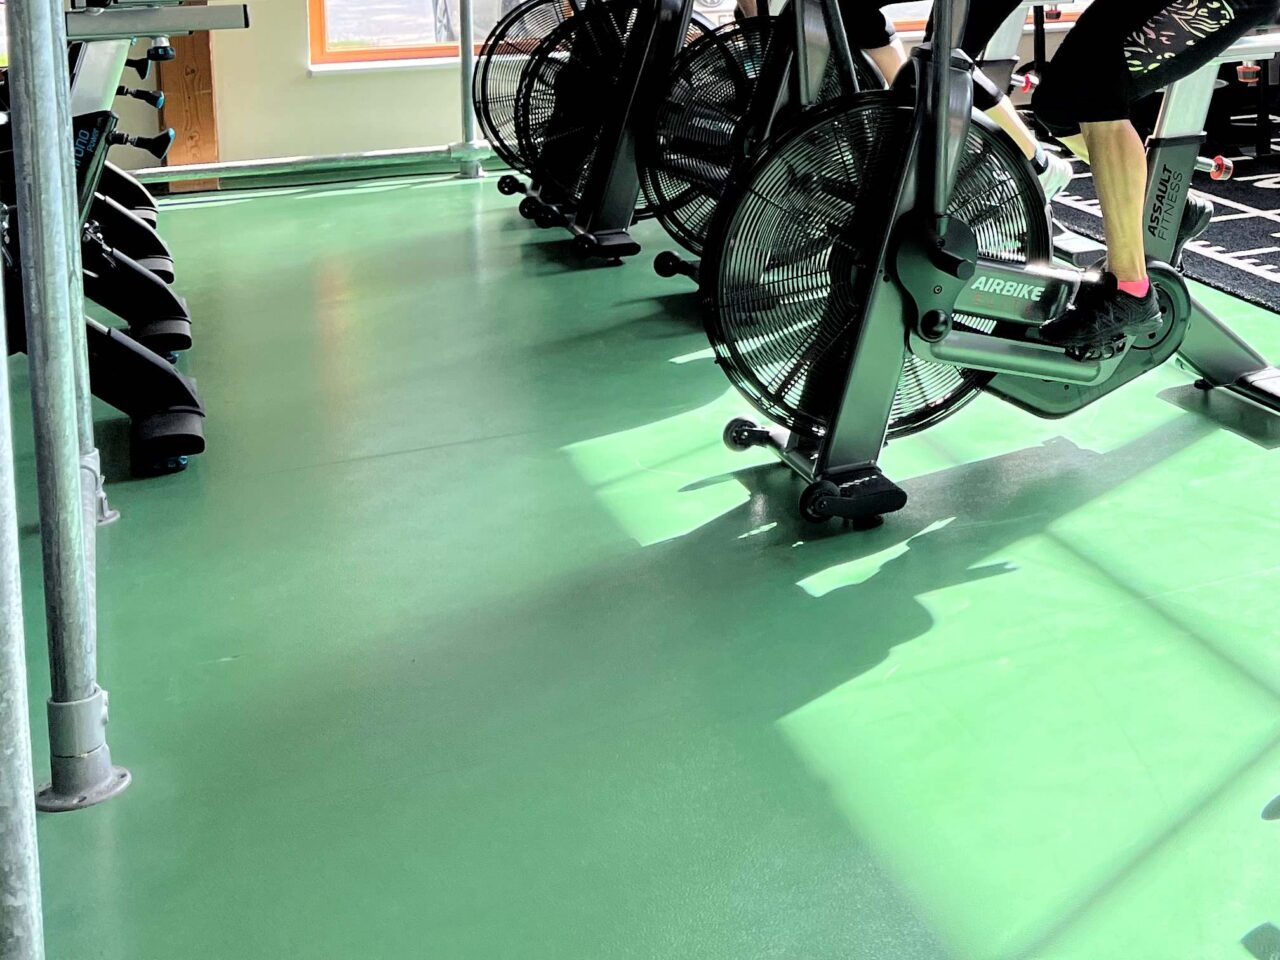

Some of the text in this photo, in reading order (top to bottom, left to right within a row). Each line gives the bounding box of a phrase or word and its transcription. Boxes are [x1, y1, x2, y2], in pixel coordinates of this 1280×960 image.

[1148, 164, 1173, 237] ASSAULT
[1158, 170, 1183, 241] FITNESS
[970, 276, 1045, 302] AIRBIKE
